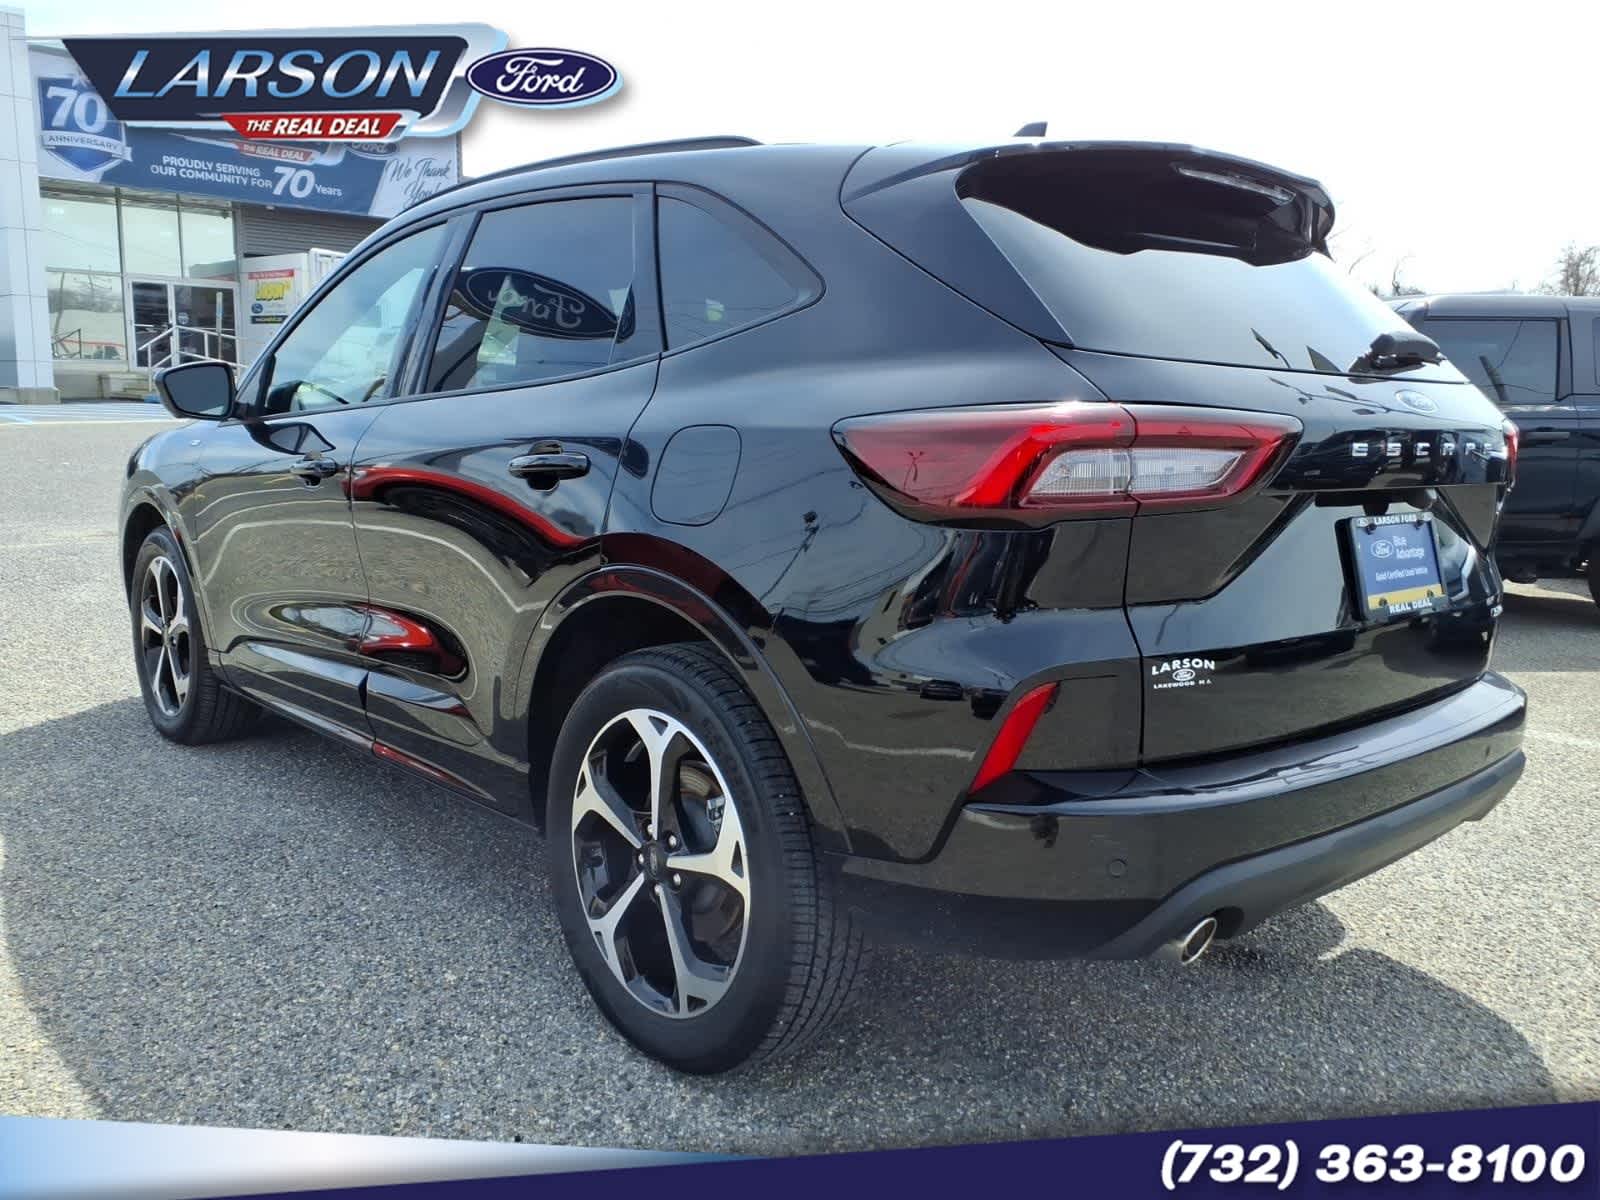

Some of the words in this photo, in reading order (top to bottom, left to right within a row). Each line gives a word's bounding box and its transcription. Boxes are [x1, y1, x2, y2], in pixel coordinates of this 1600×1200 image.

[46, 86, 107, 134] 70
[47, 135, 123, 152] ANNIVERSARY
[256, 145, 279, 158] REAL
[280, 149, 305, 161] DEAL
[162, 155, 214, 171] PROUDLY
[215, 162, 261, 177] SERVING
[150, 164, 177, 178] OUR
[179, 168, 249, 186] COMMUNITY
[251, 177, 273, 188] FOR
[273, 165, 316, 198] 70
[315, 183, 342, 197] Years
[1373, 515, 1399, 525] LARSON
[1389, 602, 1412, 614] REAL
[1413, 598, 1433, 611] DEAL
[1151, 658, 1215, 675] LARSON
